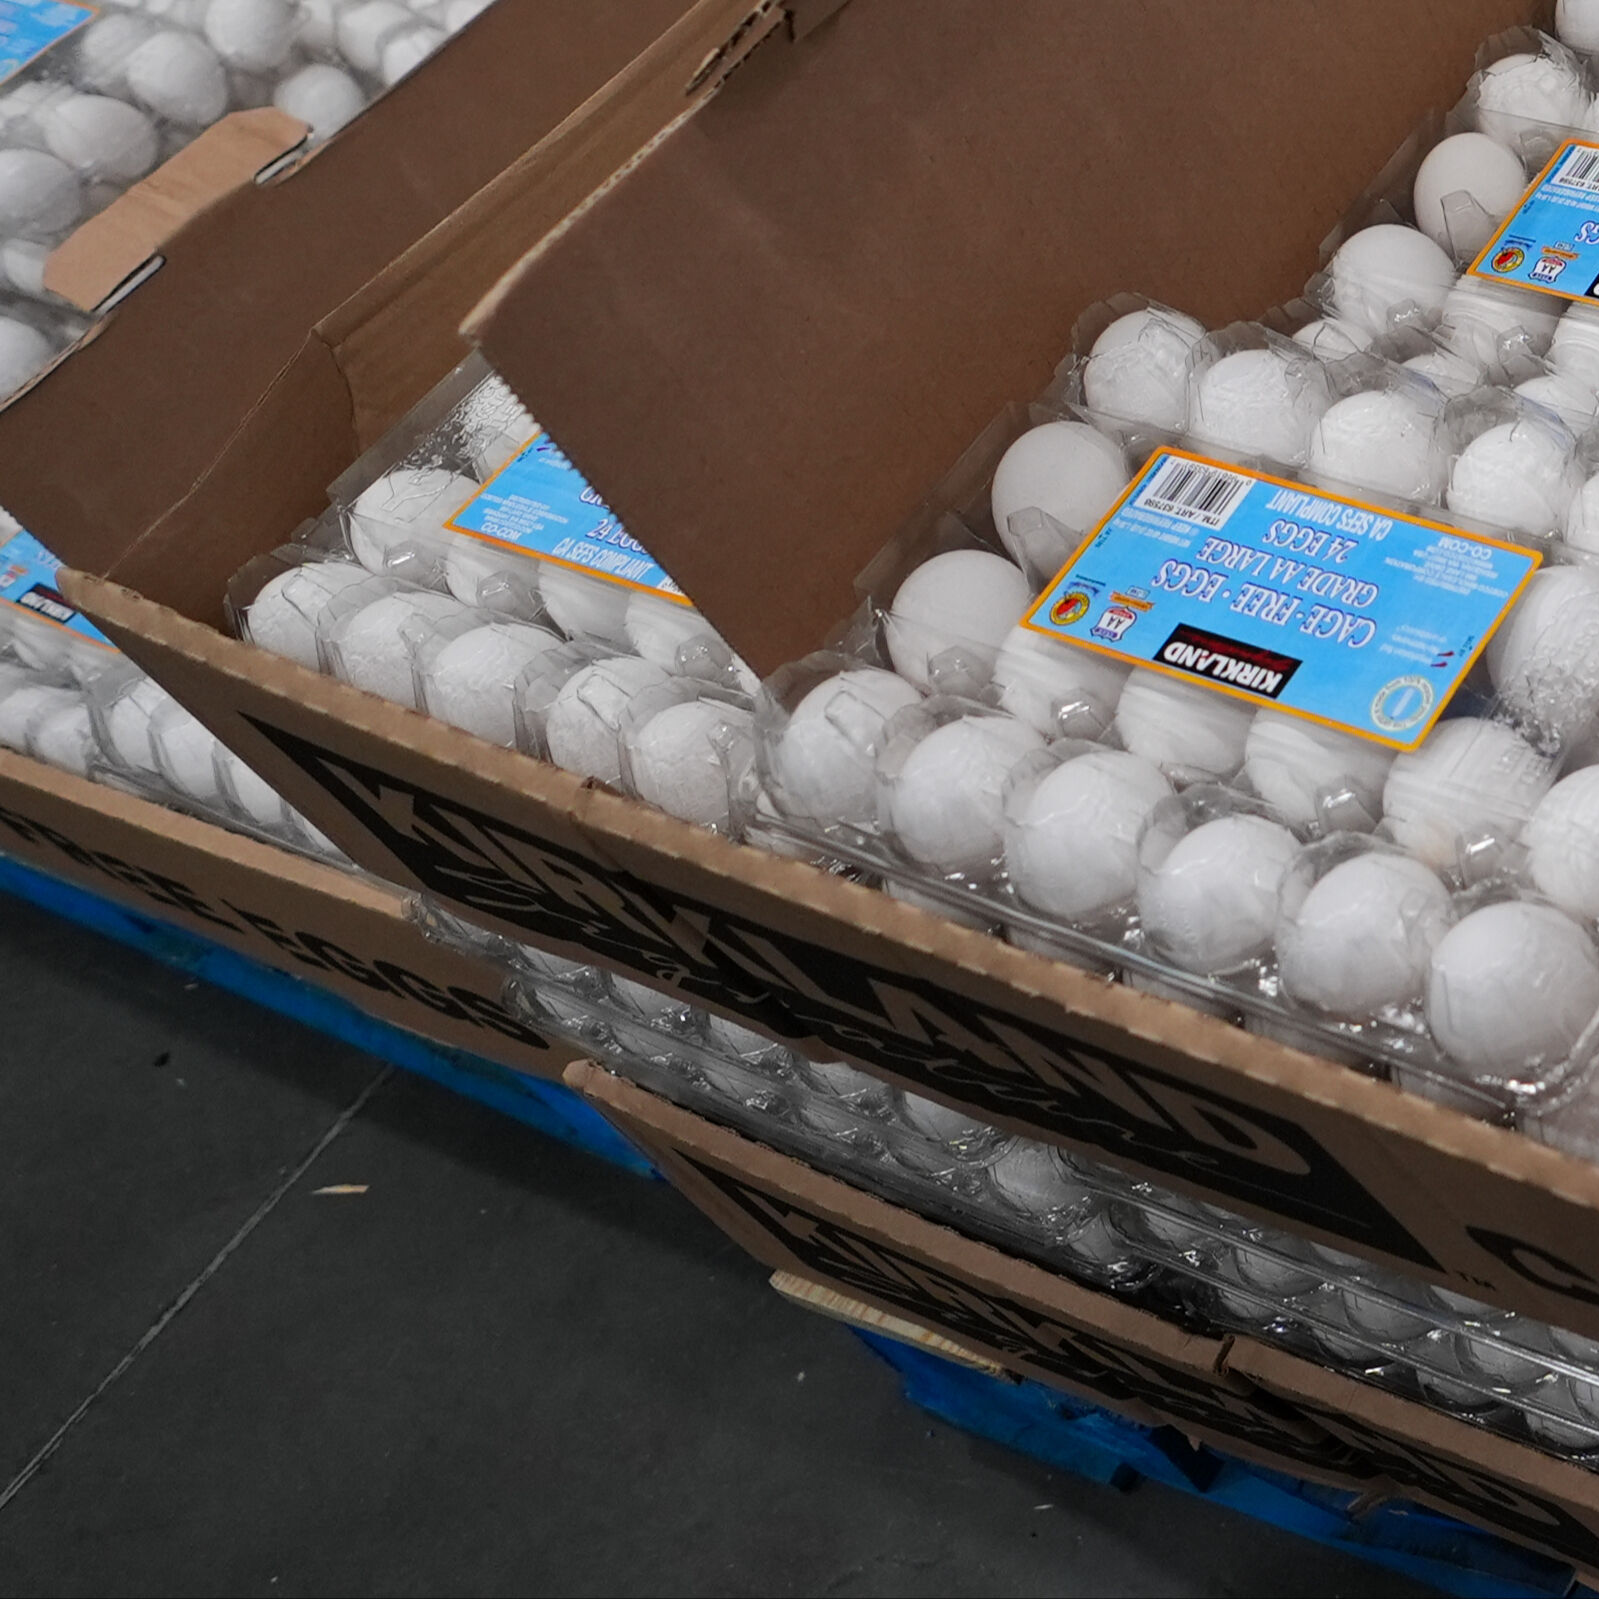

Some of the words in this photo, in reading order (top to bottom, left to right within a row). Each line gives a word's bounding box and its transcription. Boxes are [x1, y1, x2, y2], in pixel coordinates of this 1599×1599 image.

[1264, 487, 1345, 527] COMPLIANT
[1334, 506, 1378, 536] SEFS
[1261, 519, 1331, 558] EGGS
[1367, 515, 1397, 542] CA
[1194, 536, 1273, 577] LARGE
[1321, 536, 1358, 565] 24
[1149, 559, 1227, 604] EGGS
[1268, 556, 1306, 585] AA
[1295, 566, 1378, 609] GRADE
[1105, 615, 1125, 630] AA
[1163, 641, 1283, 693] KIRKLAND
[313, 755, 1312, 1176] KIRKLAND
